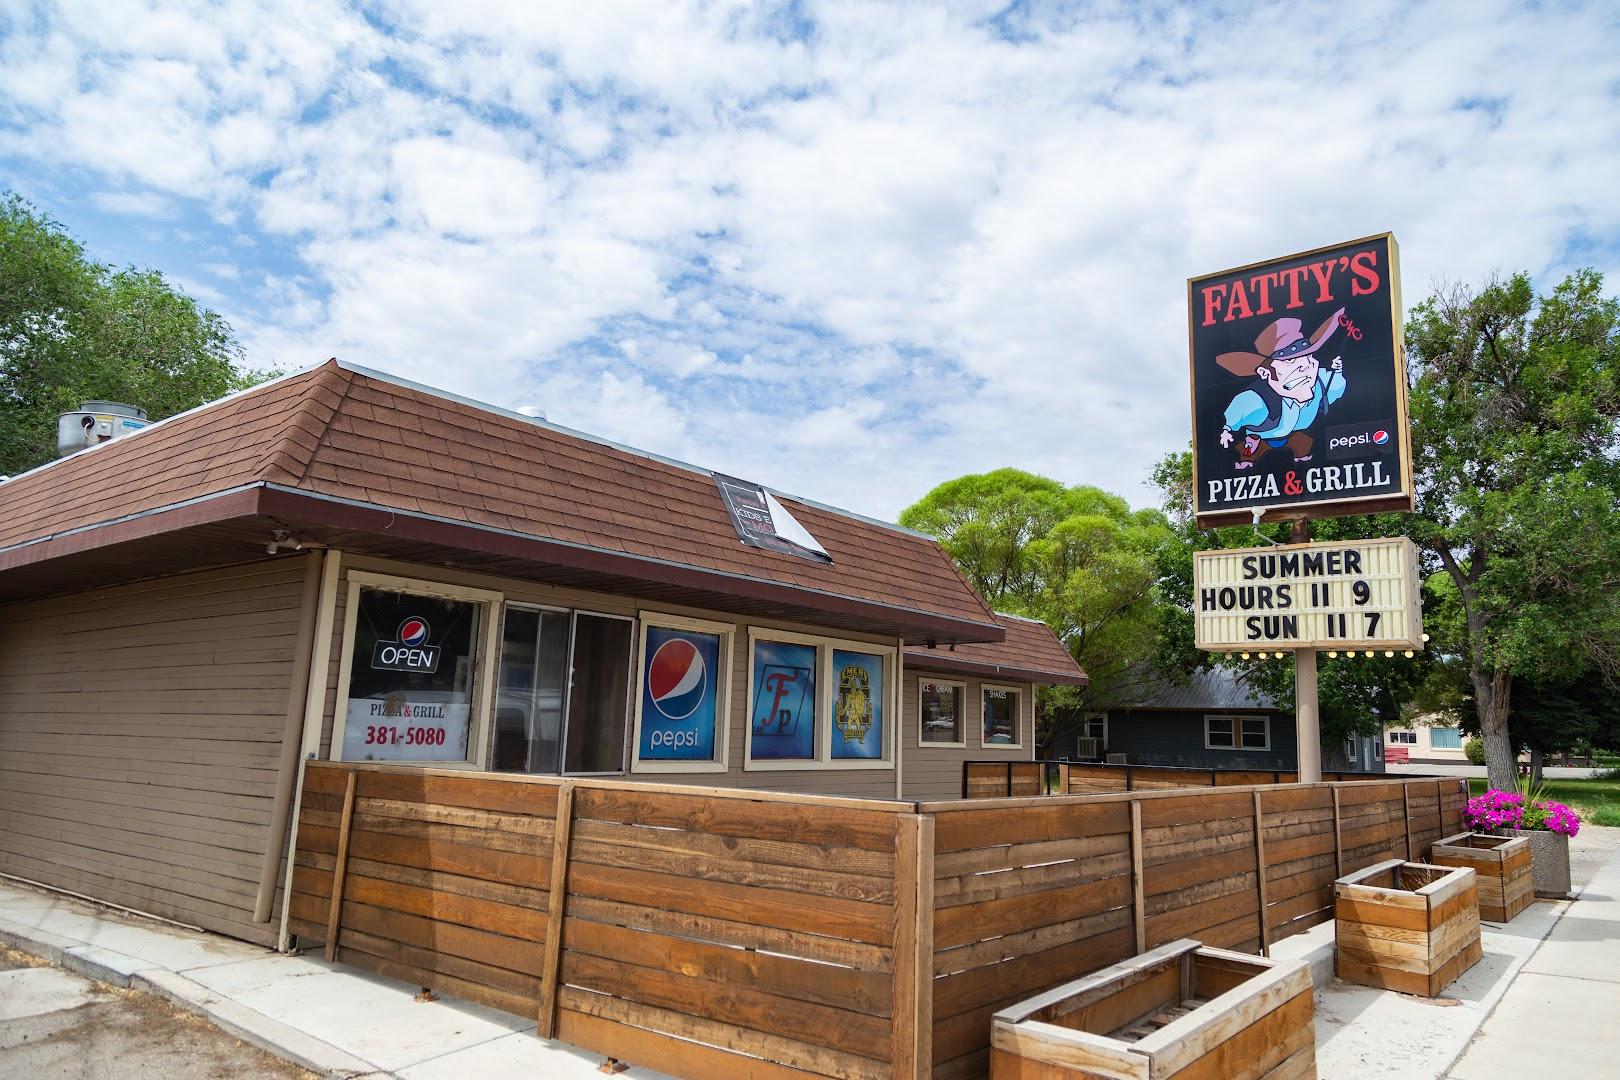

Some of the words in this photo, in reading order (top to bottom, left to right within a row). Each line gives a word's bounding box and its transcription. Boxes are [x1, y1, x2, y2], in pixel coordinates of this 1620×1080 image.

[1201, 251, 1380, 327] FATTY'S
[1329, 432, 1370, 449] pepsi
[1207, 472, 1281, 503] PIZZA
[1283, 470, 1304, 496] &
[1305, 461, 1391, 493] GRILL
[1242, 550, 1362, 580] SUMMER
[1201, 584, 1292, 611] HOURS
[1311, 583, 1329, 607] 11
[1353, 580, 1371, 605] 9
[1246, 615, 1298, 640] SUN
[1327, 613, 1346, 638] 11
[1364, 612, 1381, 637] 7
[381, 647, 433, 668] OPEN
[403, 705, 412, 718] &
[413, 705, 445, 718] GRILL
[365, 725, 446, 746] 381-5080
[650, 728, 699, 750] pepsi
